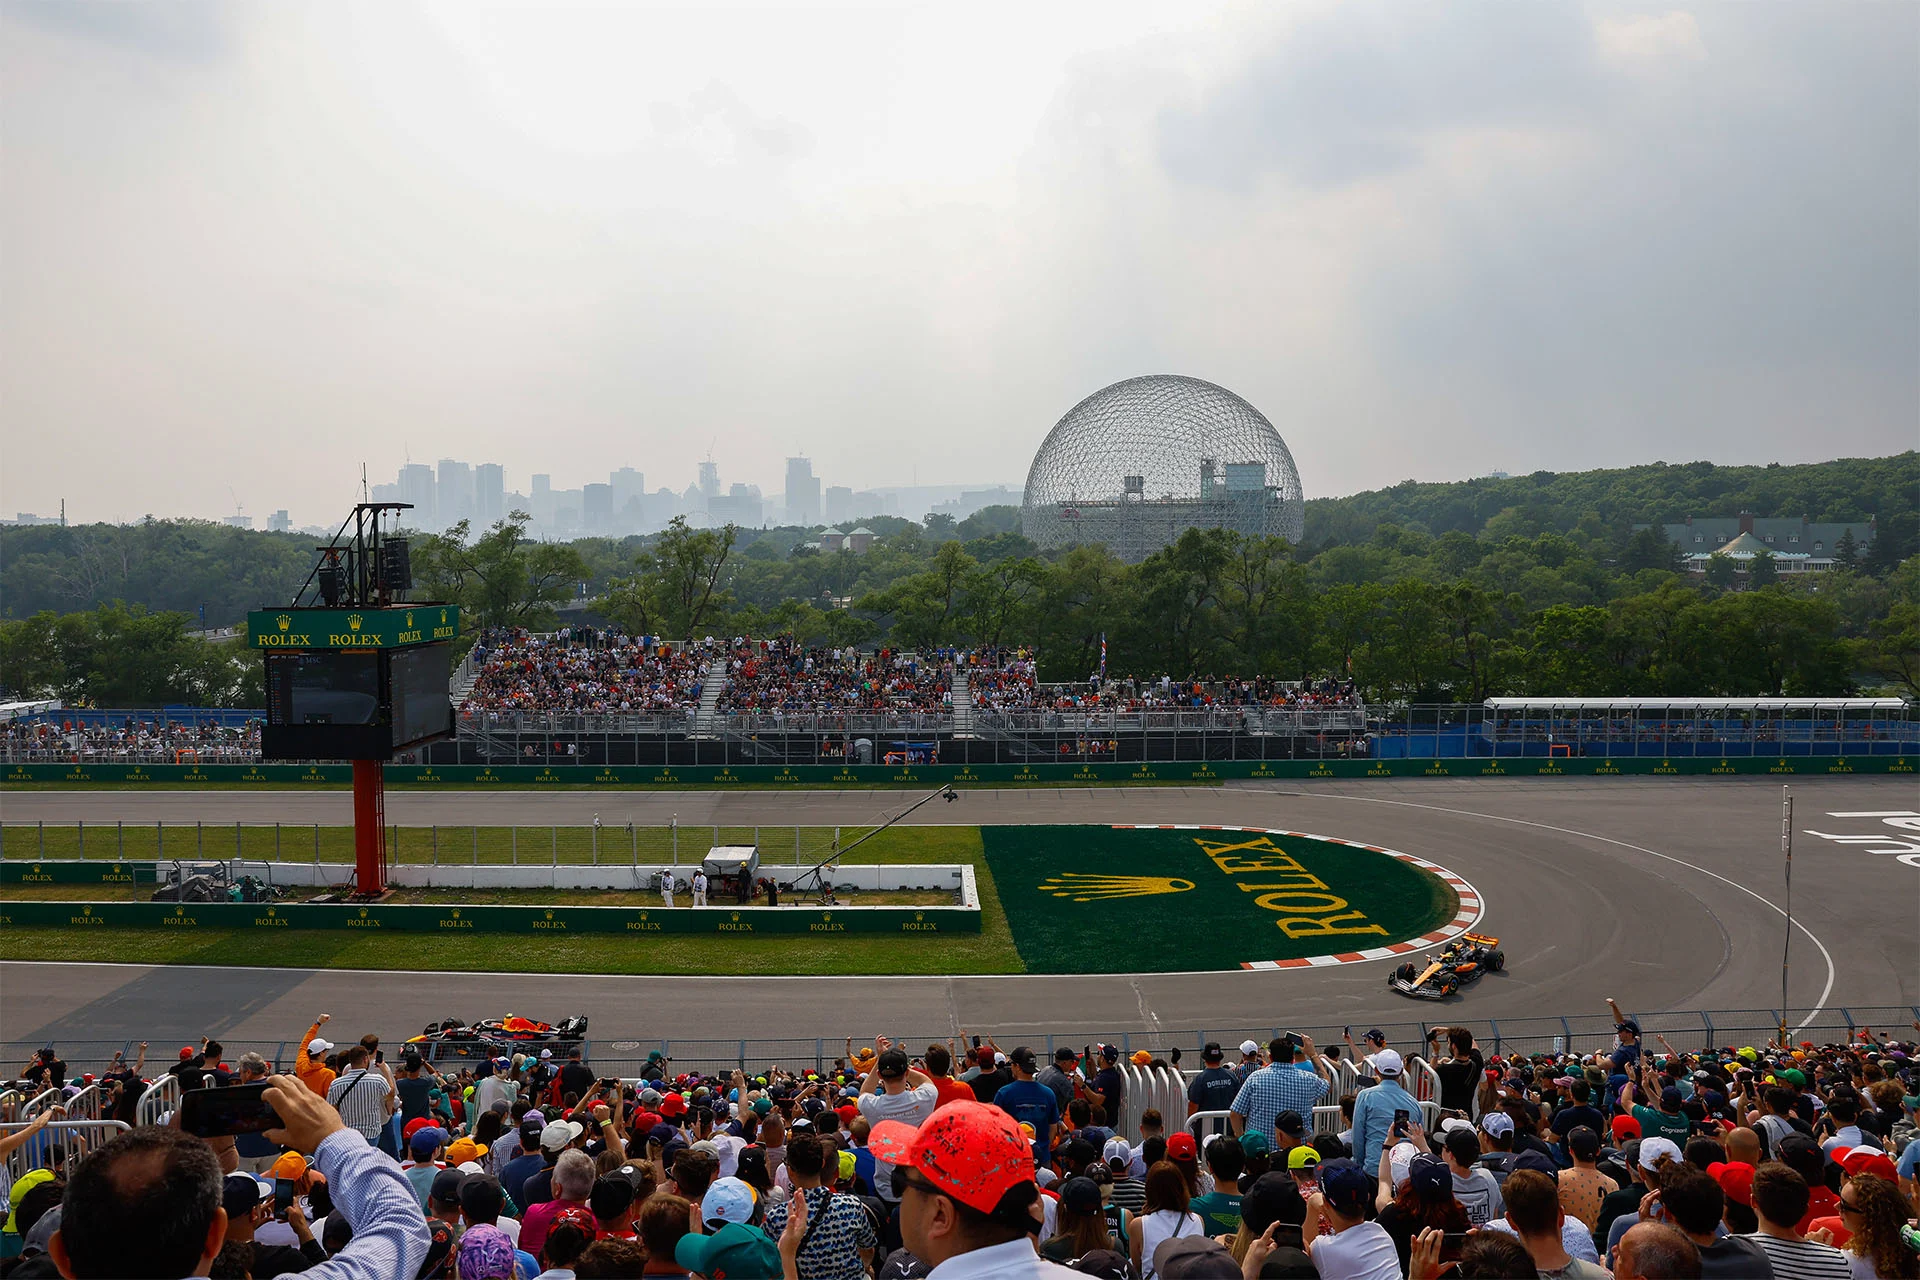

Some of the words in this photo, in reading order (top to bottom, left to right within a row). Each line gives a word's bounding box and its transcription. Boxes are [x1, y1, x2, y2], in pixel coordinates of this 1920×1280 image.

[433, 626, 454, 638] ROLEX
[258, 635, 311, 645] ROLEX
[329, 634, 383, 645] ROLEX
[399, 630, 421, 643] ROLEX
[1193, 837, 1390, 939] ROLEX
[255, 918, 288, 926] ROLEX
[347, 919, 380, 927] ROLEX
[440, 920, 472, 928] ROLEX
[627, 922, 660, 930] ROLEX
[718, 923, 753, 931] ROLEX
[810, 923, 844, 931] ROLEX
